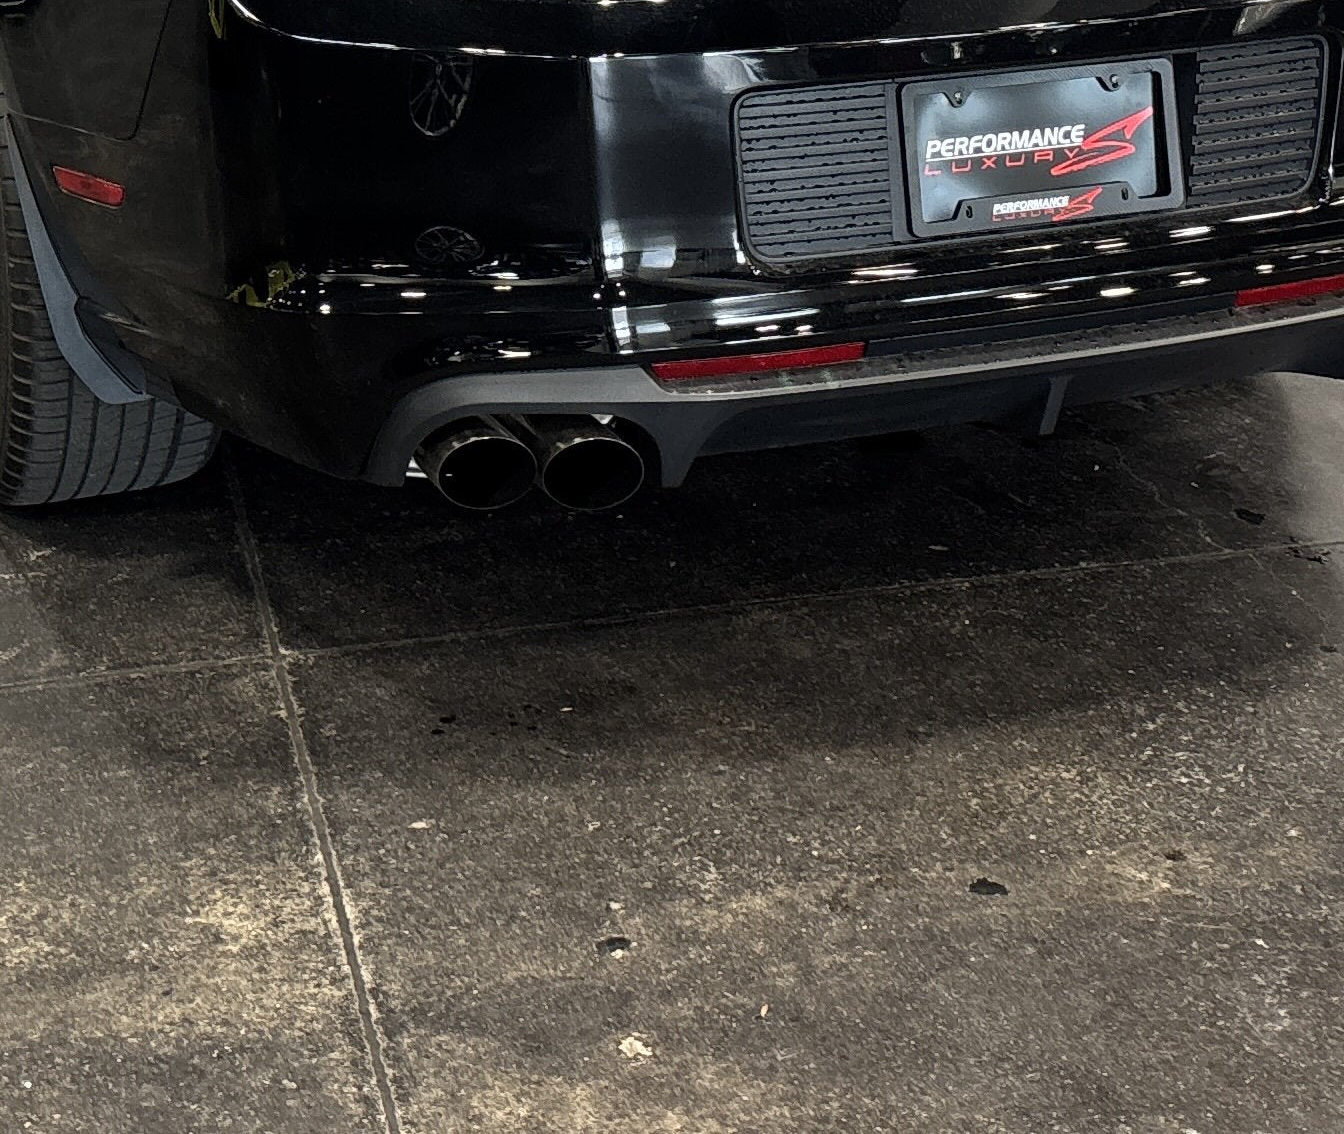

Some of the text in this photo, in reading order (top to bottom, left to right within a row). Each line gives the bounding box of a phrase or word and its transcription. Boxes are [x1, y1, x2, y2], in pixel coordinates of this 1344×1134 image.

[925, 125, 1085, 160] PERFORMANCE
[924, 149, 1080, 176] LUXURY
[993, 196, 1070, 214] PERFORMANCE
